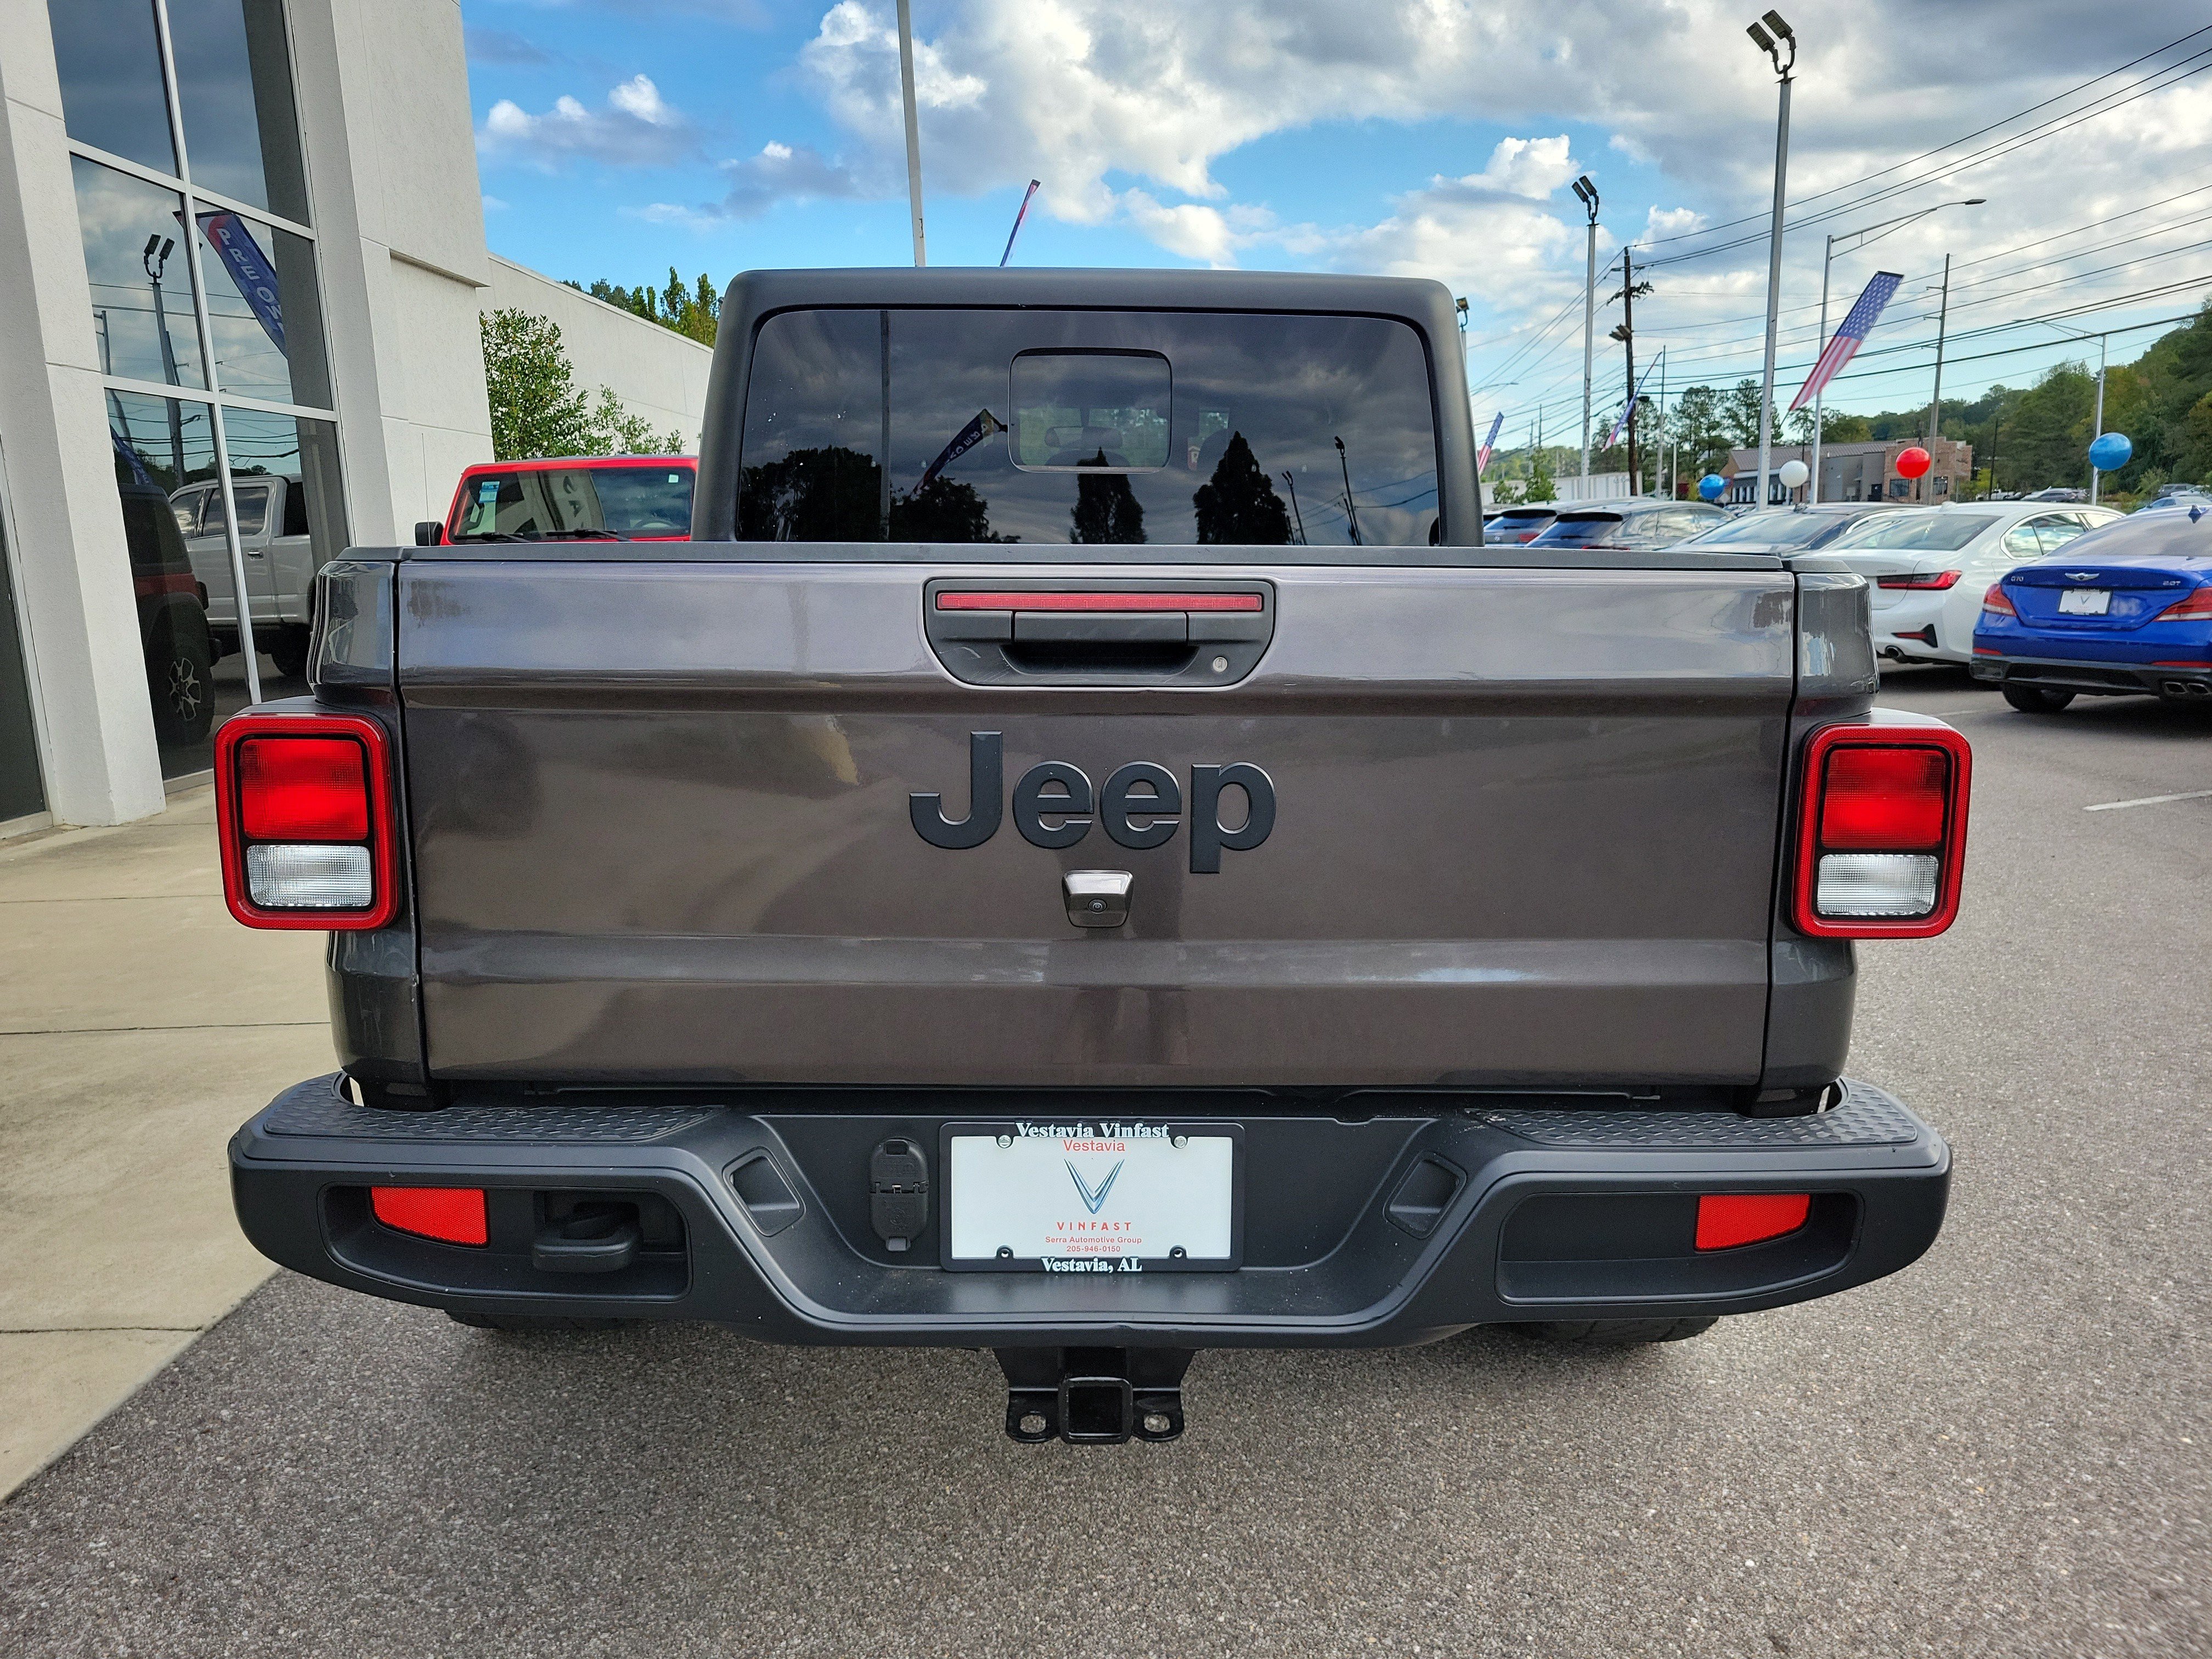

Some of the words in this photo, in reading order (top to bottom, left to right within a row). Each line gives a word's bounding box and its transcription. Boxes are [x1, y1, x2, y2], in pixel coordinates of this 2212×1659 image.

[216, 228, 260, 280] PRE
[910, 731, 1276, 873] Jeep
[1015, 1122, 1094, 1138] Vestavia
[1099, 1122, 1169, 1138] Vinfast
[1063, 1139, 1125, 1152] Vestavia
[1057, 1221, 1131, 1231] VINFAST
[1117, 1236, 1142, 1244] Group
[1041, 1257, 1114, 1273] Vestavia,
[1117, 1257, 1142, 1272] AL
